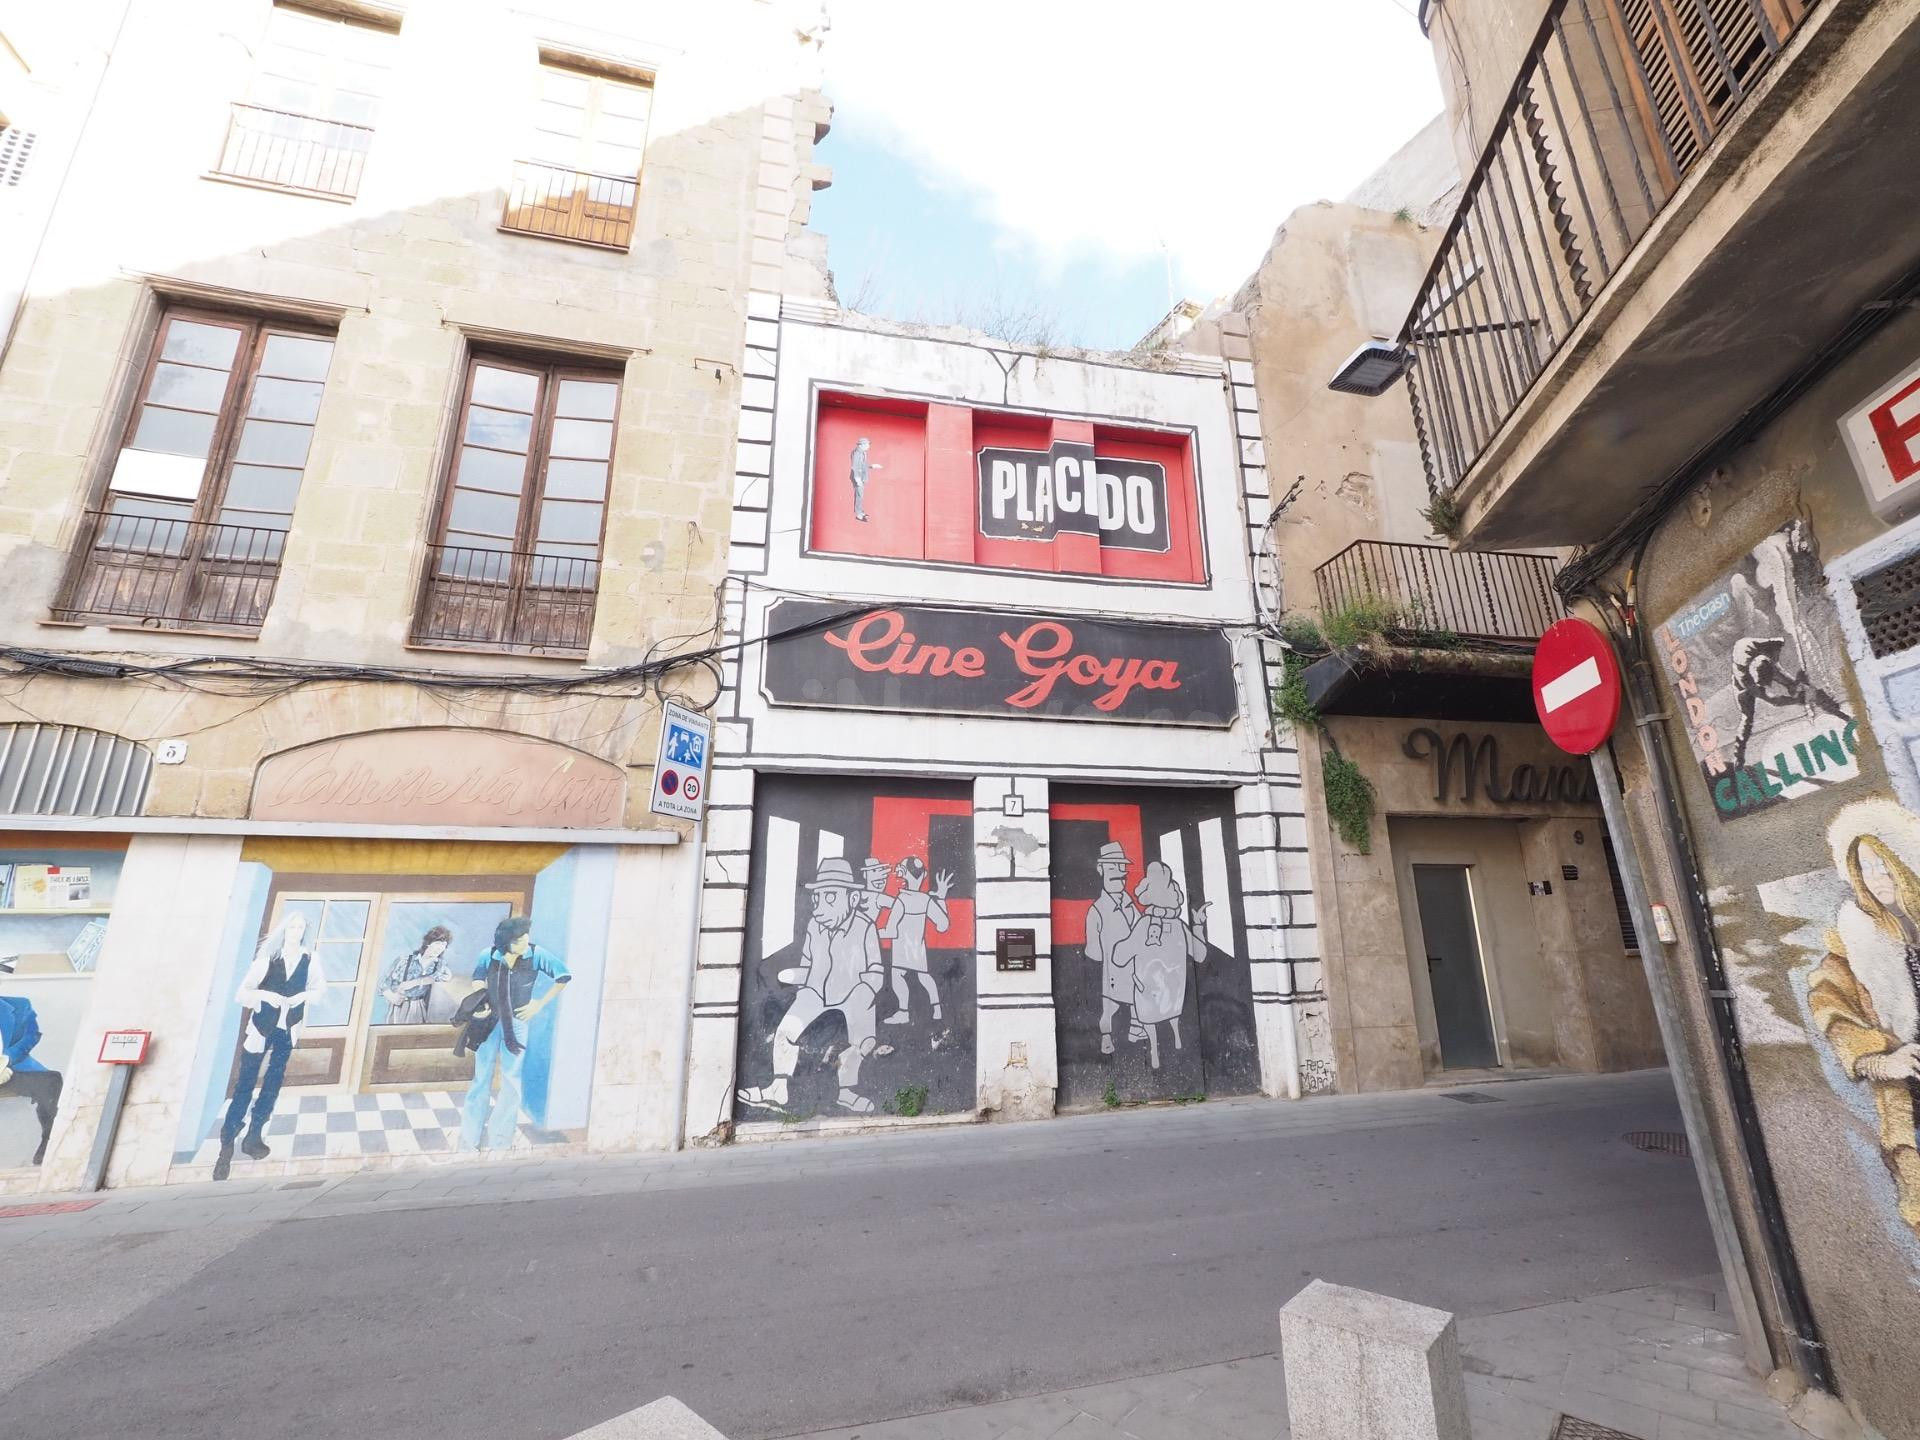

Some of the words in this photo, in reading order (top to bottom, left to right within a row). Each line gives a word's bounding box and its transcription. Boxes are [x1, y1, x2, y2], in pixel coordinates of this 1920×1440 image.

[992, 456, 1156, 535] PLACIDO
[1698, 592, 1731, 623] Clash
[824, 610, 986, 678] Cine
[1000, 621, 1182, 711] Goya
[1663, 623, 1727, 776] LONDON
[668, 709, 681, 719] ZONA
[687, 783, 697, 793] 20
[663, 801, 676, 810] TOTA
[683, 806, 697, 814] ZONA
[1010, 800, 1016, 812] 7
[1573, 830, 1584, 845] 9
